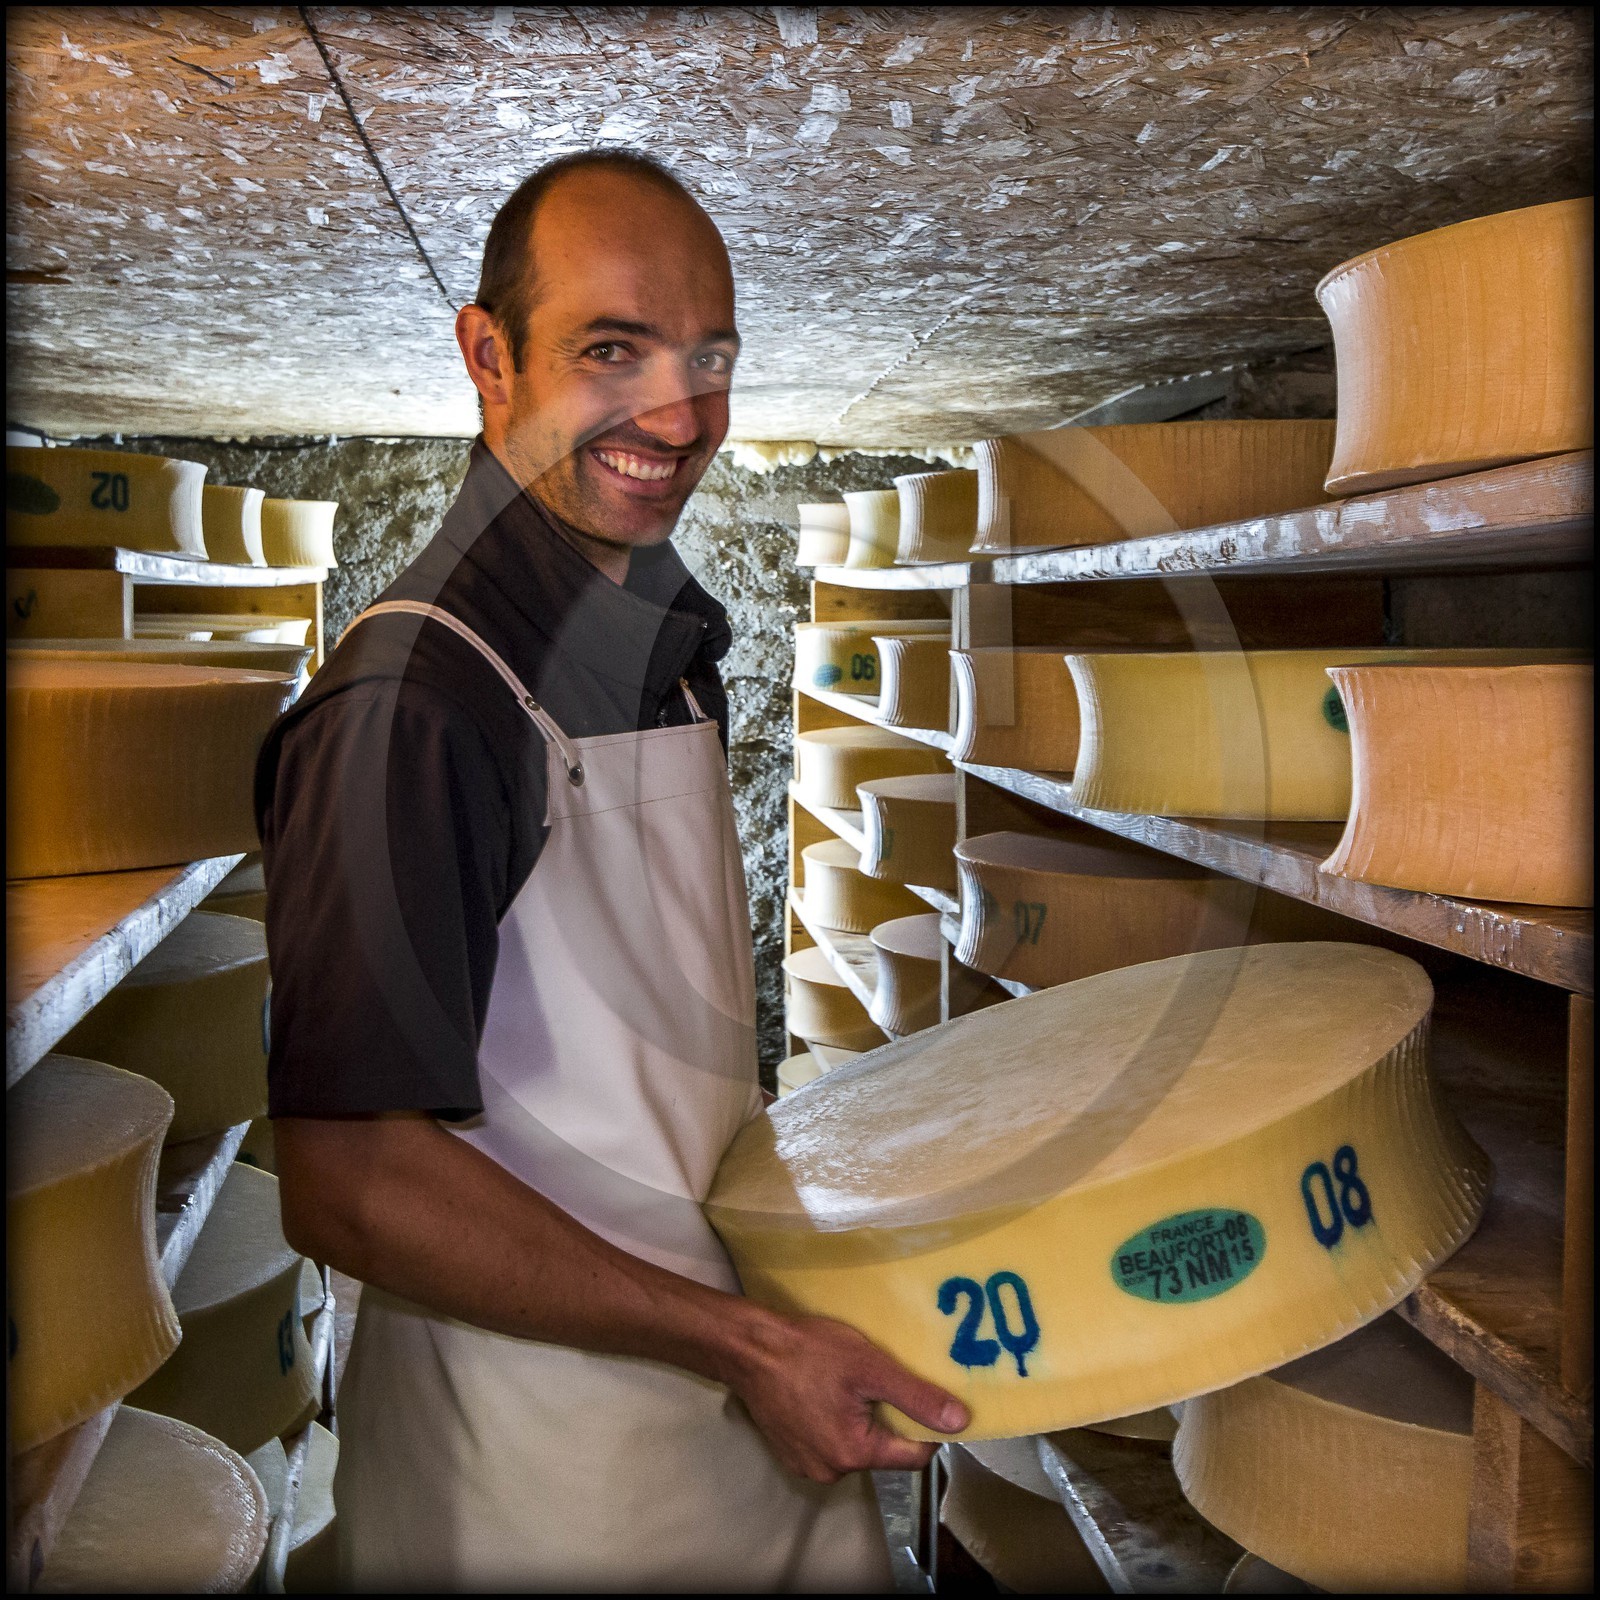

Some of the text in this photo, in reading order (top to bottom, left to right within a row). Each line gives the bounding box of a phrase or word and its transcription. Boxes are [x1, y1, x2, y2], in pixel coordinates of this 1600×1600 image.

[1301, 1144, 1373, 1250] 08
[1150, 1215, 1215, 1245] FRANCE
[1224, 1212, 1249, 1241] 08
[1118, 1229, 1228, 1275] BEAUFORT
[1230, 1238, 1255, 1266] 15
[937, 1271, 1041, 1377] 20
